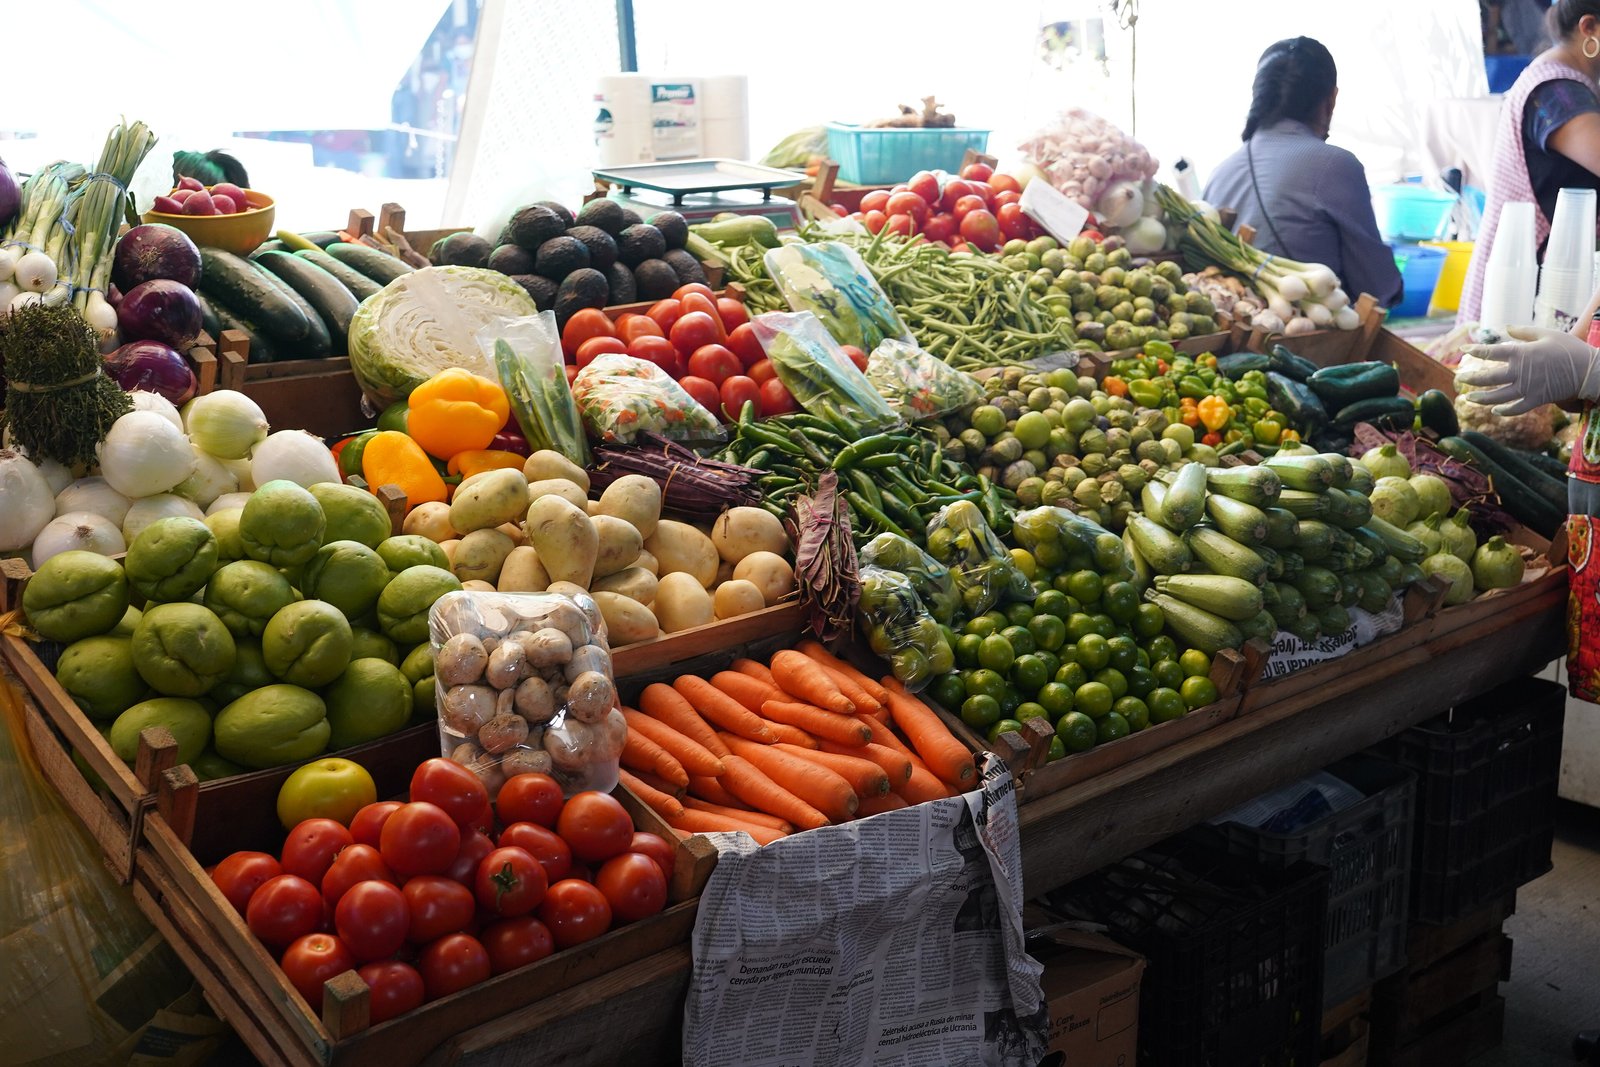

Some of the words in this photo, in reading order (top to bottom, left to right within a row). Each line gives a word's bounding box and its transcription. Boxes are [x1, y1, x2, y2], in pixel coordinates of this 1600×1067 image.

[729, 974, 759, 985] cerrada
[757, 974, 772, 985] por
[794, 965, 834, 978] municipal
[739, 964, 778, 975] Demandan
[801, 956, 831, 964] escuela
[881, 1024, 908, 1037] Zelenski
[908, 1022, 925, 1031] acusa
[930, 1018, 946, 1027] Rusia
[946, 1015, 954, 1023] de
[955, 1013, 976, 1022] minar
[1055, 1014, 1075, 1026] Care
[878, 1034, 902, 1047] central
[902, 1028, 941, 1042] hidroeléctrica
[941, 1026, 949, 1034] de
[950, 1022, 977, 1032] Ucrania
